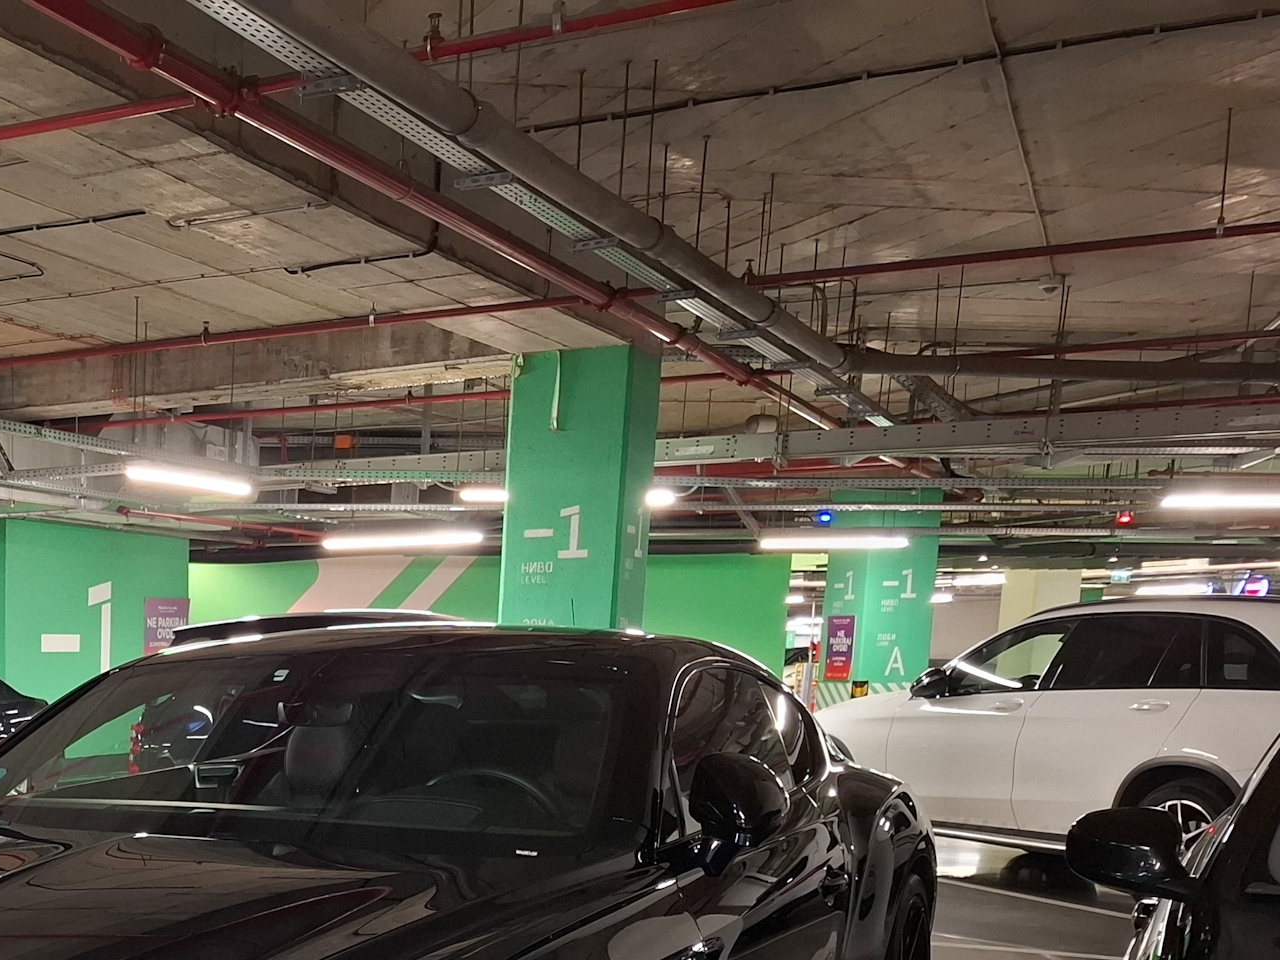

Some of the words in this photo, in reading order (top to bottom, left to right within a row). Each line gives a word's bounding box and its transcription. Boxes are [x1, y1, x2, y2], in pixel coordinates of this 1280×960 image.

[523, 505, 588, 559] -1
[521, 561, 554, 574] НИВО
[521, 576, 546, 584] LEVEL
[147, 617, 157, 628] NE
[884, 646, 905, 676] A
